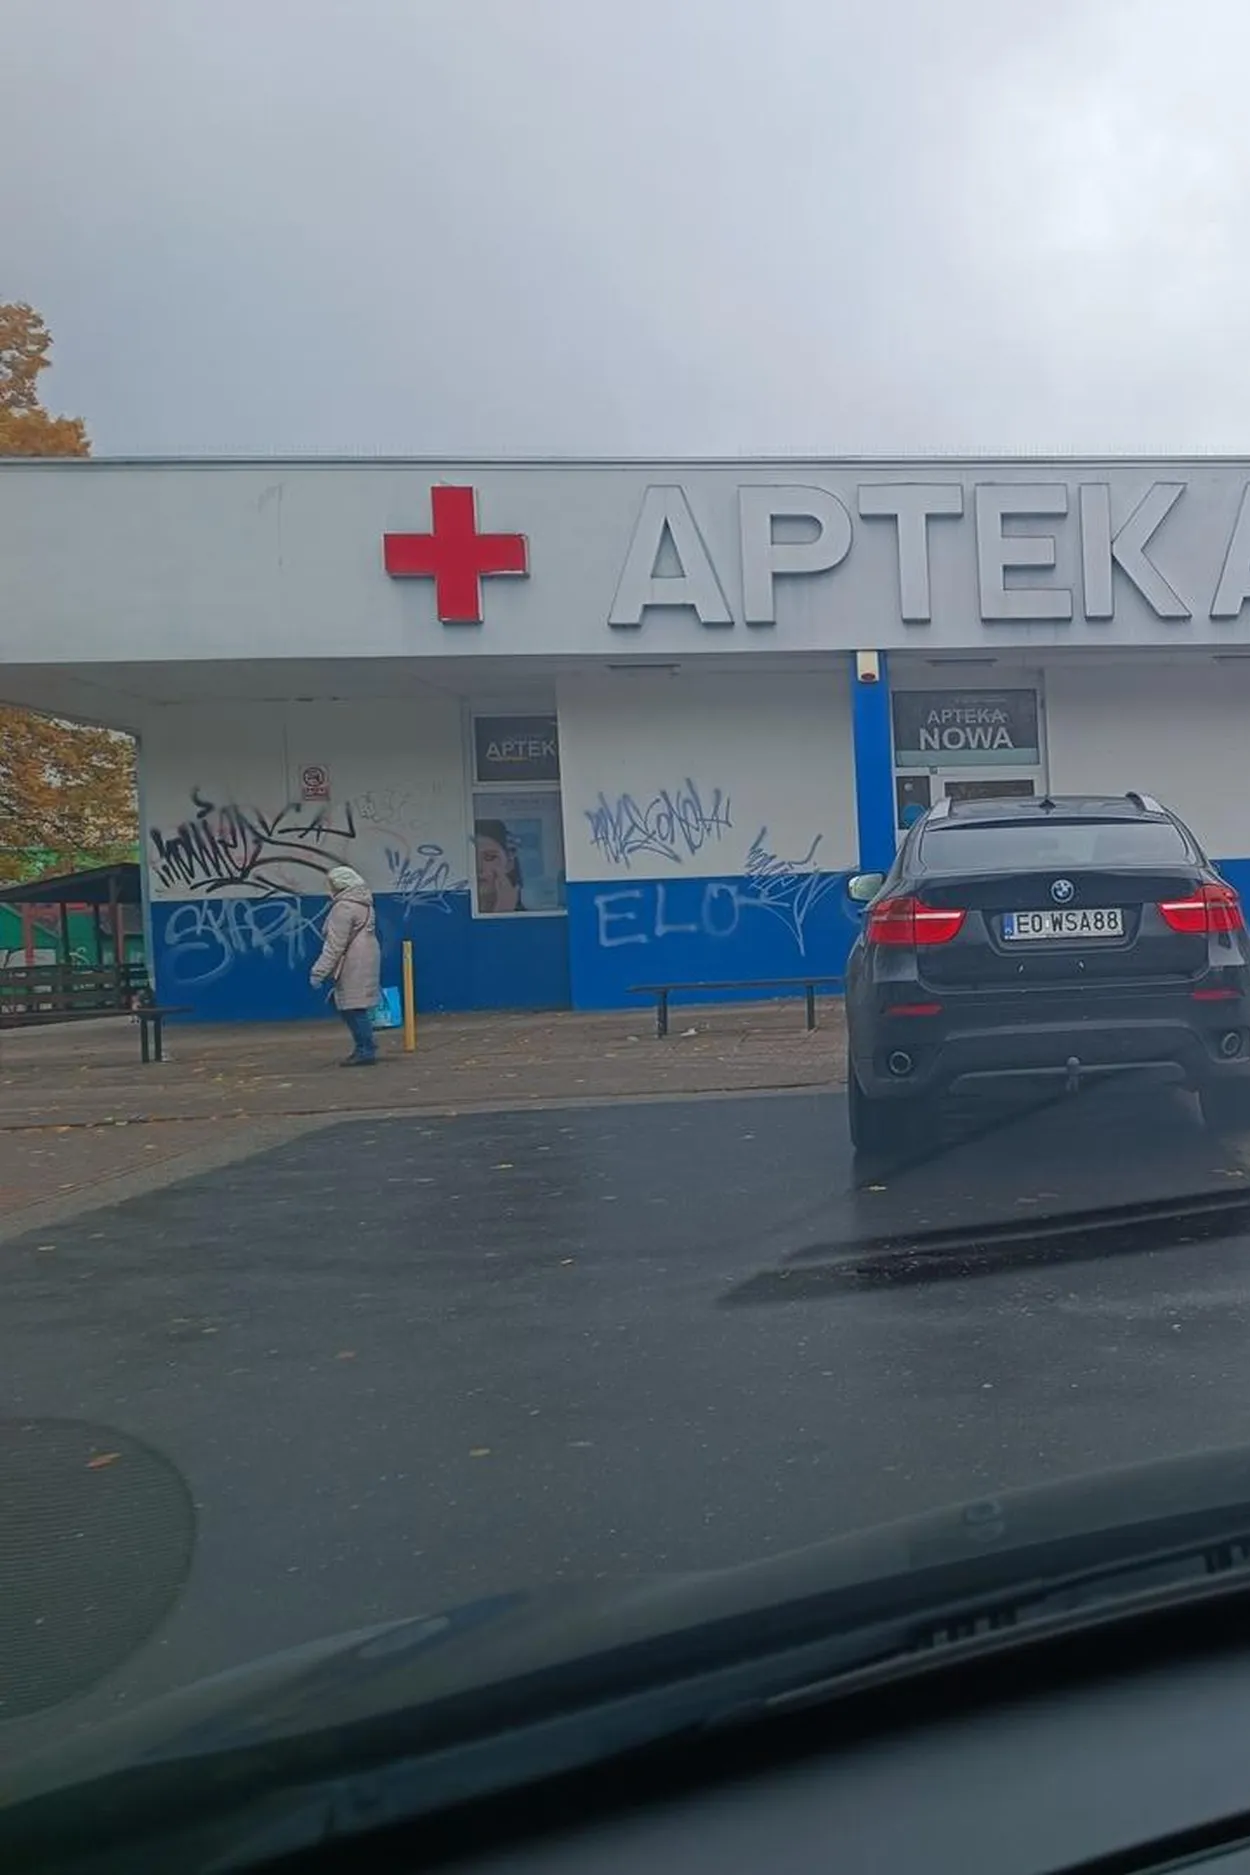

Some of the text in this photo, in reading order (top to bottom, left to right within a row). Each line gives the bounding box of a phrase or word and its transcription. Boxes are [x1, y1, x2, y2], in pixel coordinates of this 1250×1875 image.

[927, 707, 1006, 725] APTEKA
[918, 727, 1015, 751] NOWA
[1051, 911, 1119, 932] WSA88
